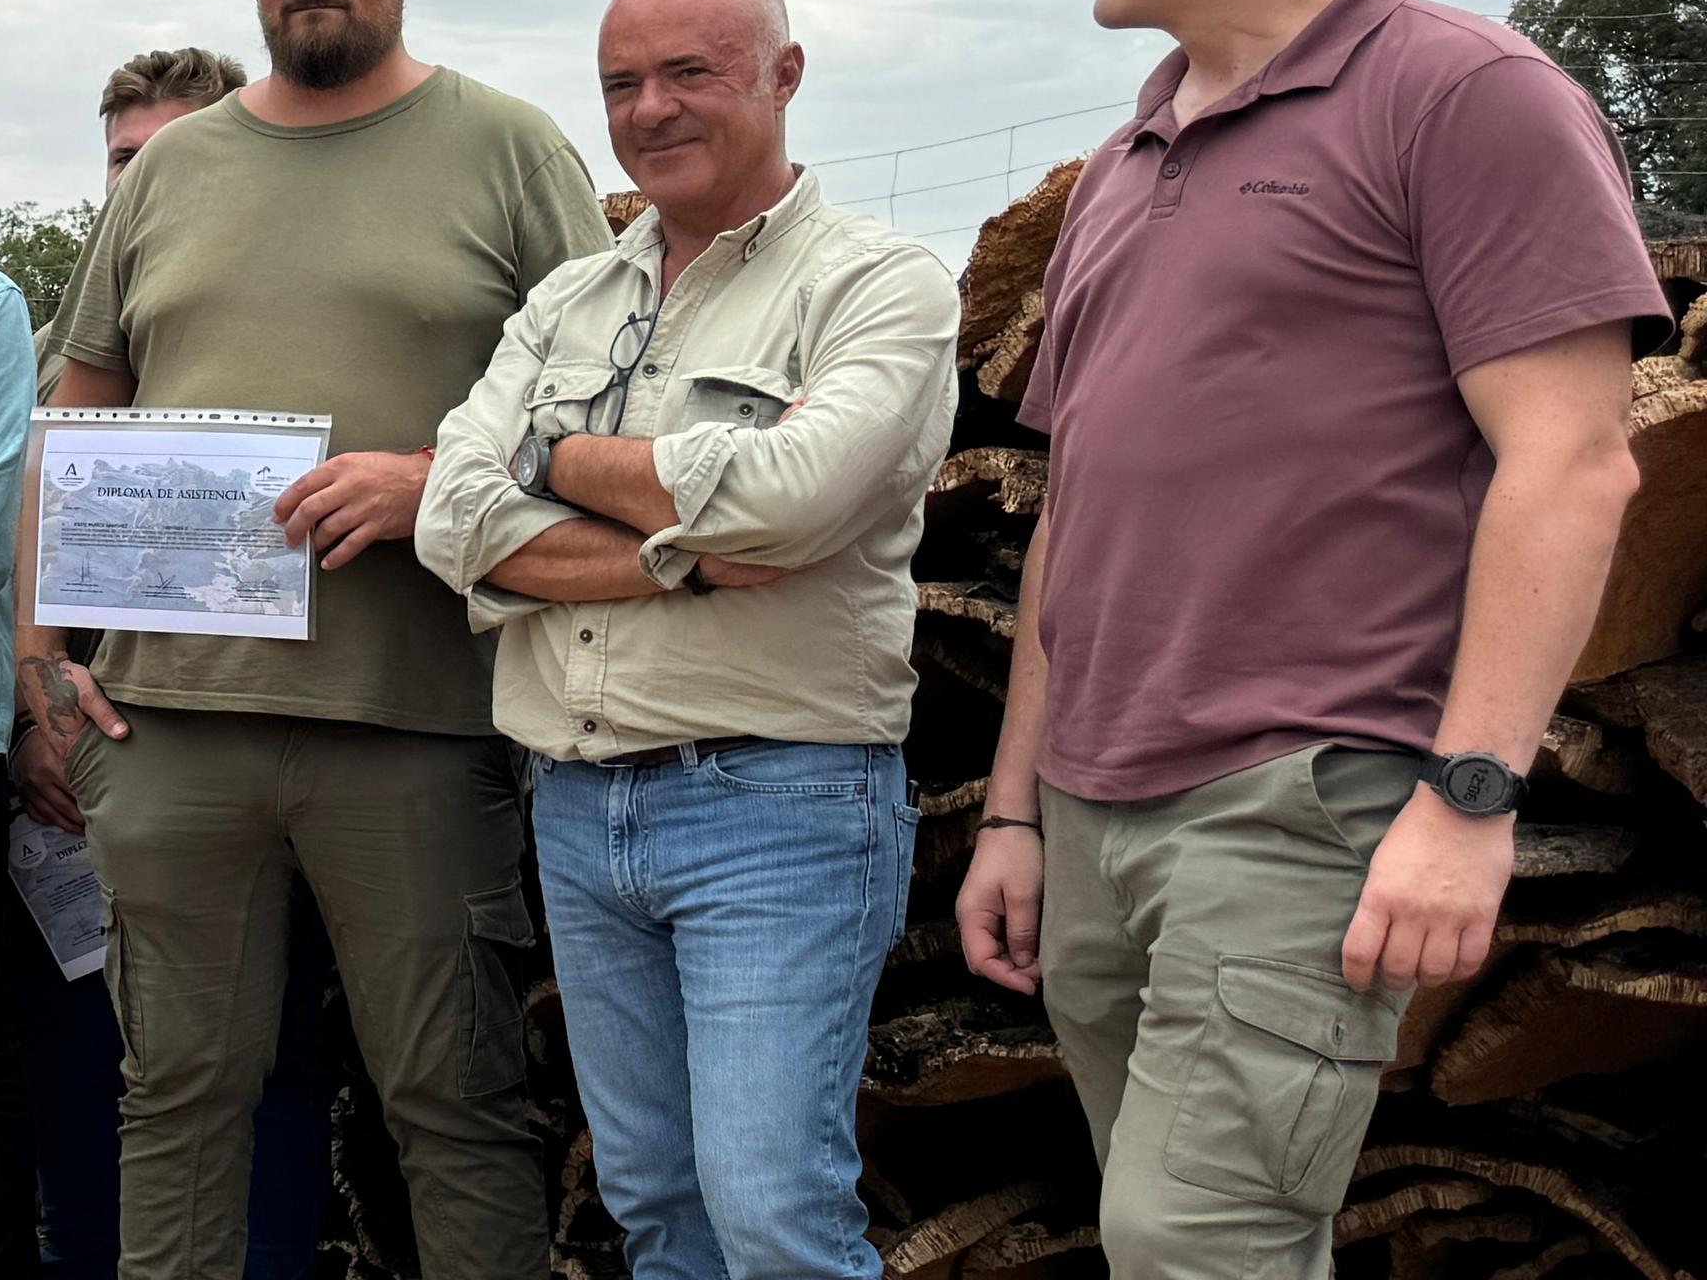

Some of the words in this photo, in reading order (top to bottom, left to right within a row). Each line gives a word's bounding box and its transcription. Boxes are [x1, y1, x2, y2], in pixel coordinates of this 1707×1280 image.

[97, 487, 153, 499] DIPLOMA
[157, 488, 173, 499] DE
[177, 489, 246, 500] ASISTENCIA
[56, 840, 87, 860] DIPLO
